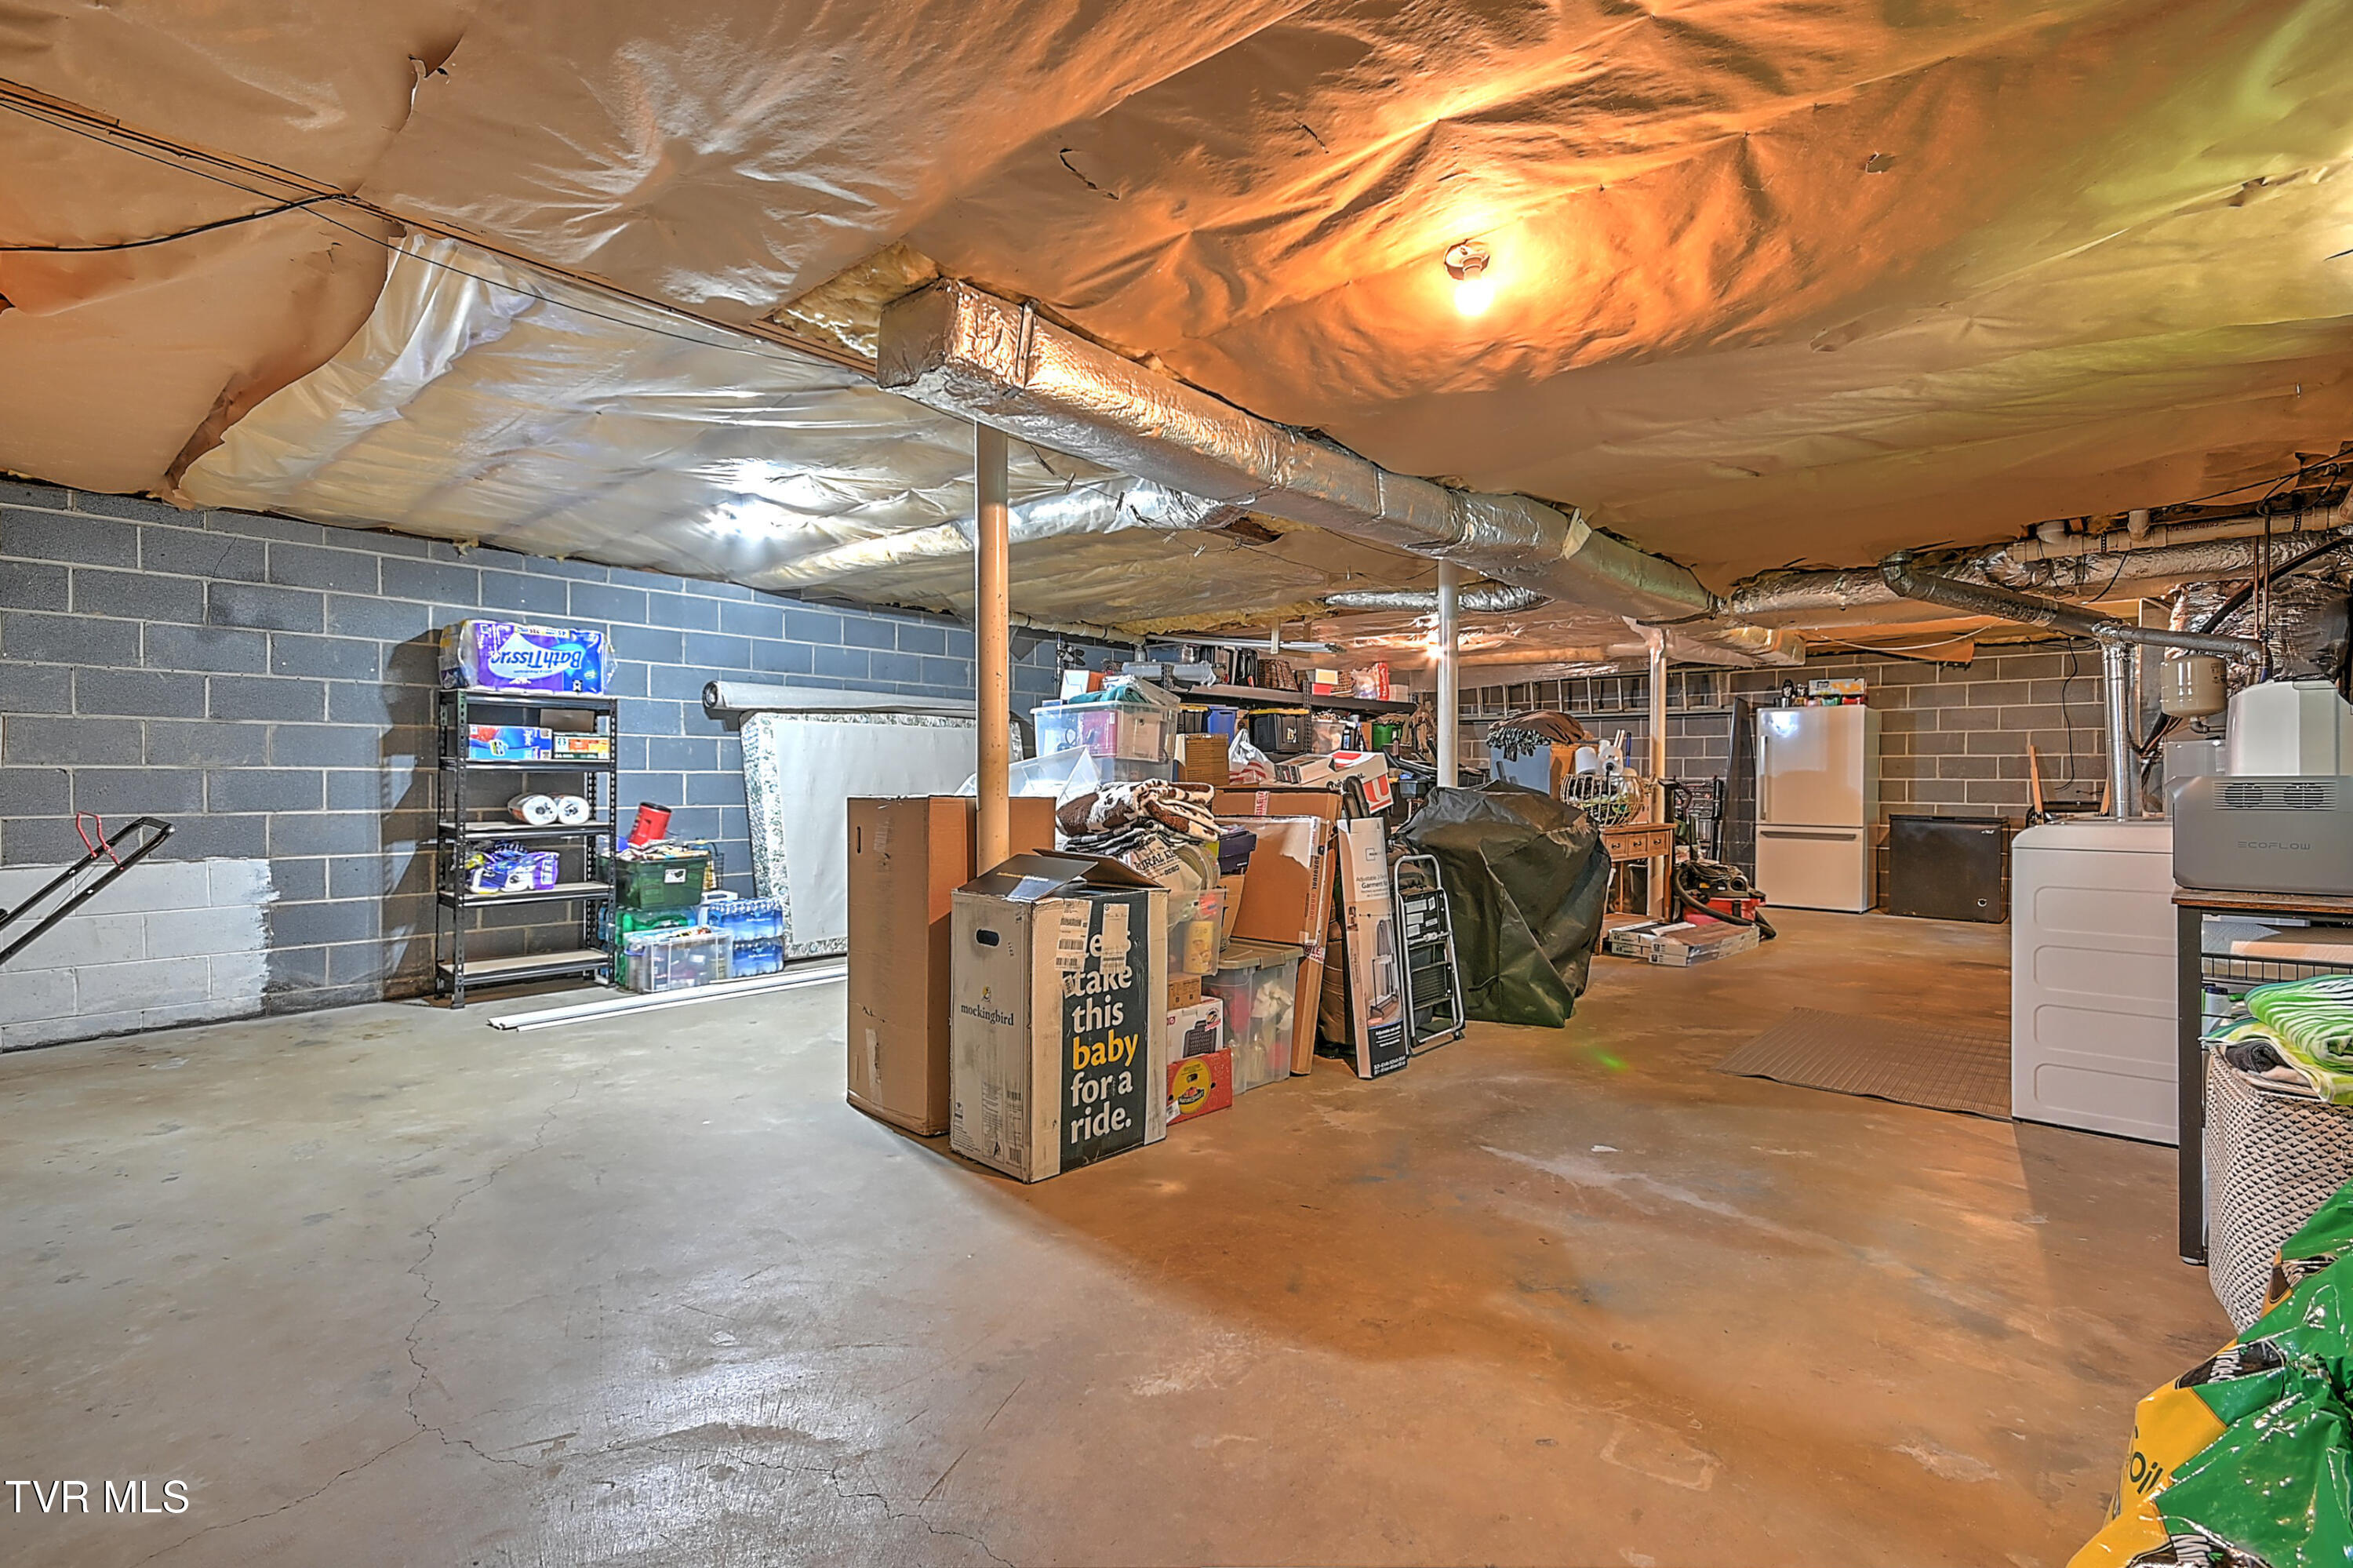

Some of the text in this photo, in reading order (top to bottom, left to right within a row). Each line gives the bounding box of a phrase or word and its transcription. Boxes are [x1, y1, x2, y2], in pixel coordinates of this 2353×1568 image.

[544, 650, 582, 668] Bath
[2238, 841, 2311, 850] ECOFLOW
[1073, 966, 1133, 997] take
[961, 1004, 1014, 1026] mockingbird
[1072, 994, 1124, 1034] this
[1072, 1028, 1139, 1071] baby
[1070, 1070, 1133, 1108] for a
[1070, 1101, 1132, 1145] ride.
